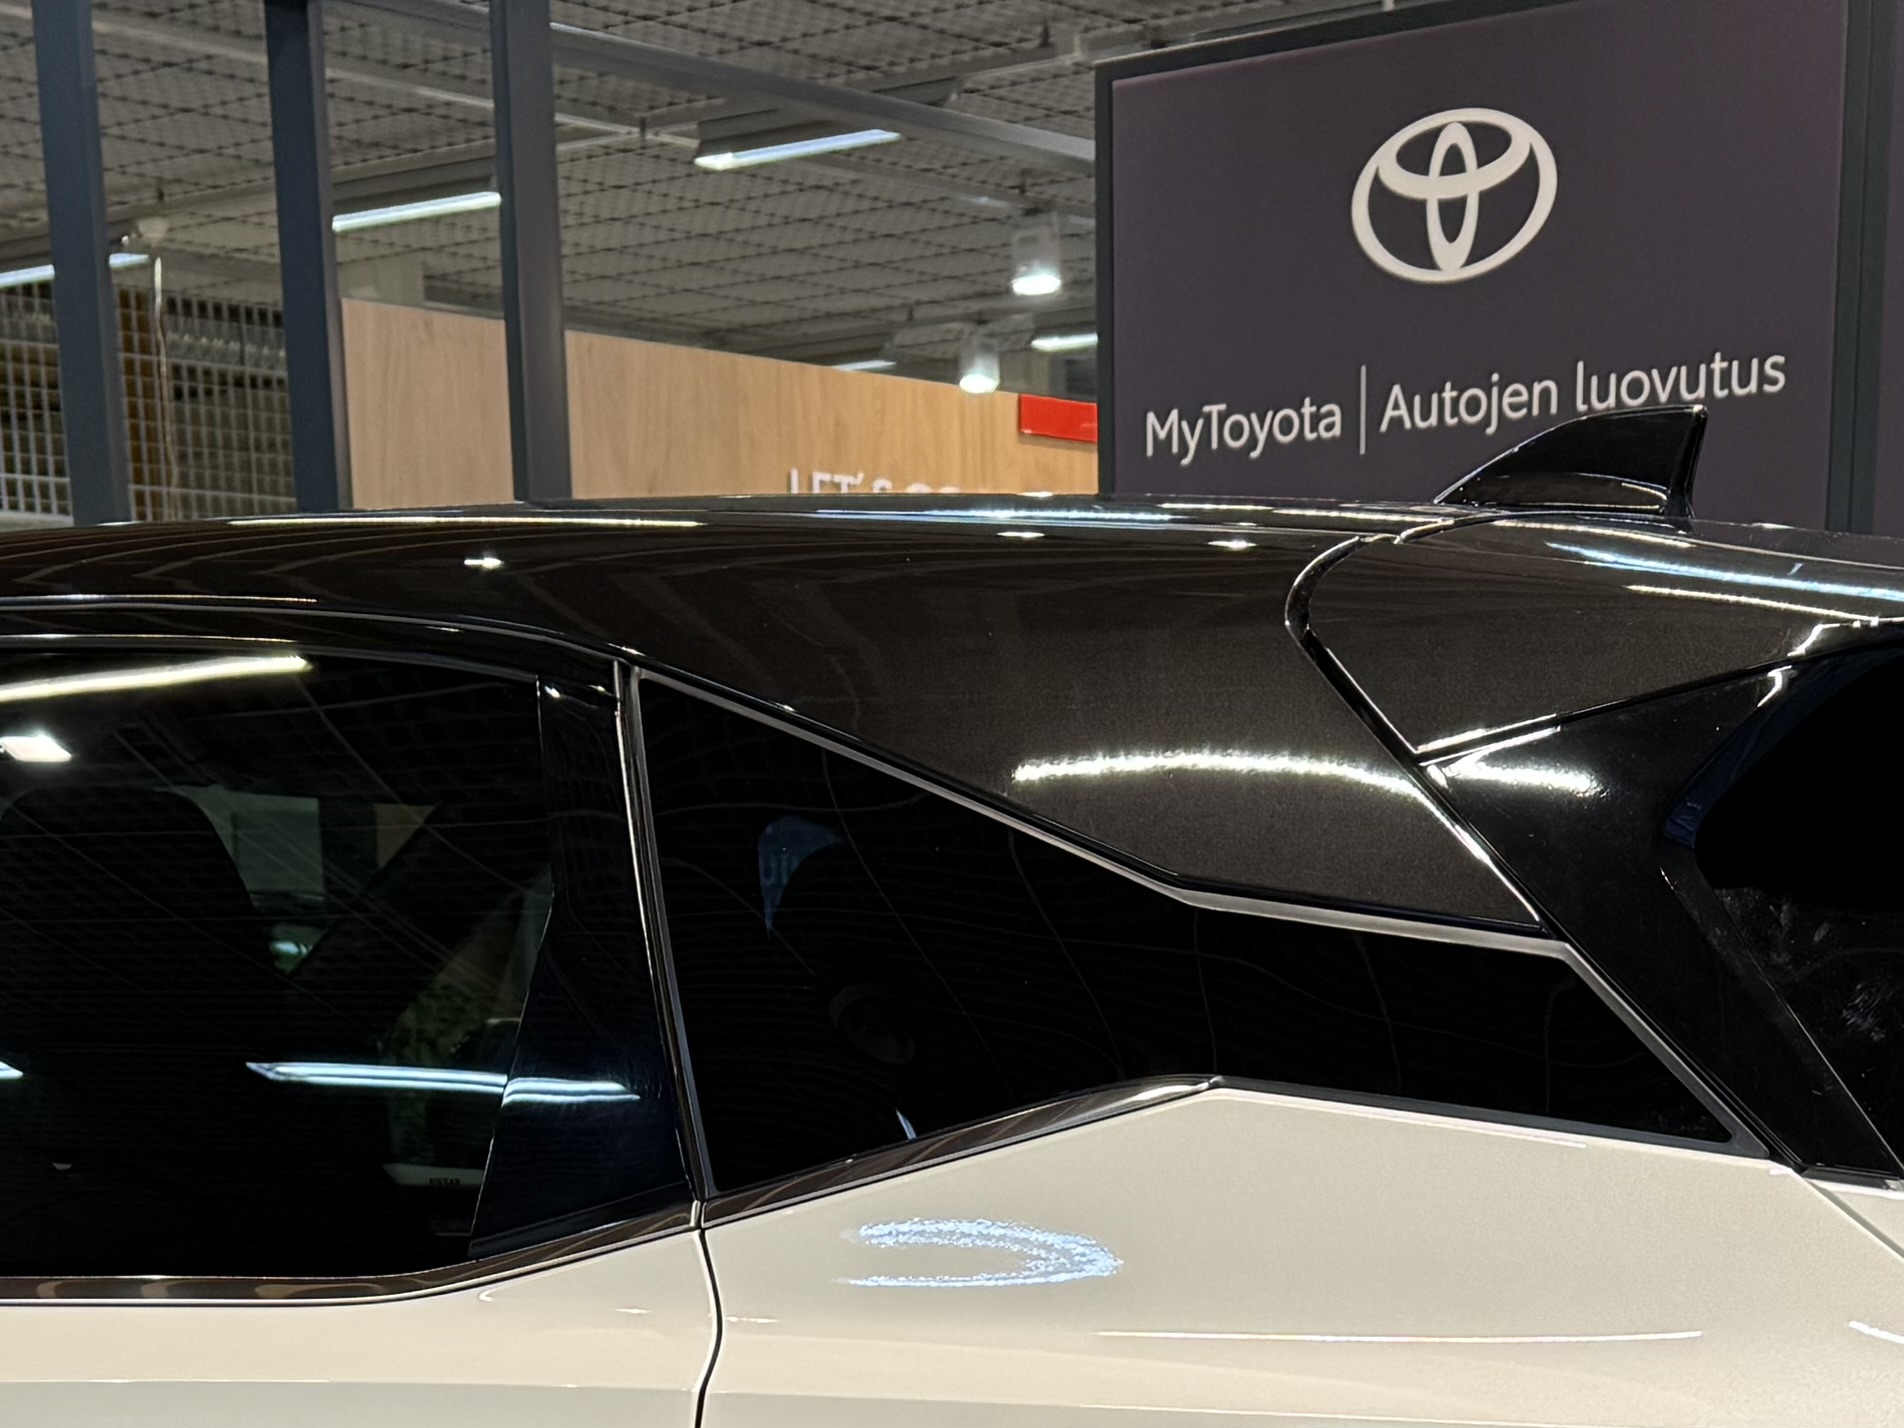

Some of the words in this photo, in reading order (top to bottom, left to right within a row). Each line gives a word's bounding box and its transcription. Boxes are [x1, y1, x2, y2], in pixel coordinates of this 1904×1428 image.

[1145, 397, 1343, 466] MyToyota
[1379, 372, 1559, 434] Autojen
[1575, 352, 1787, 413] luovutus
